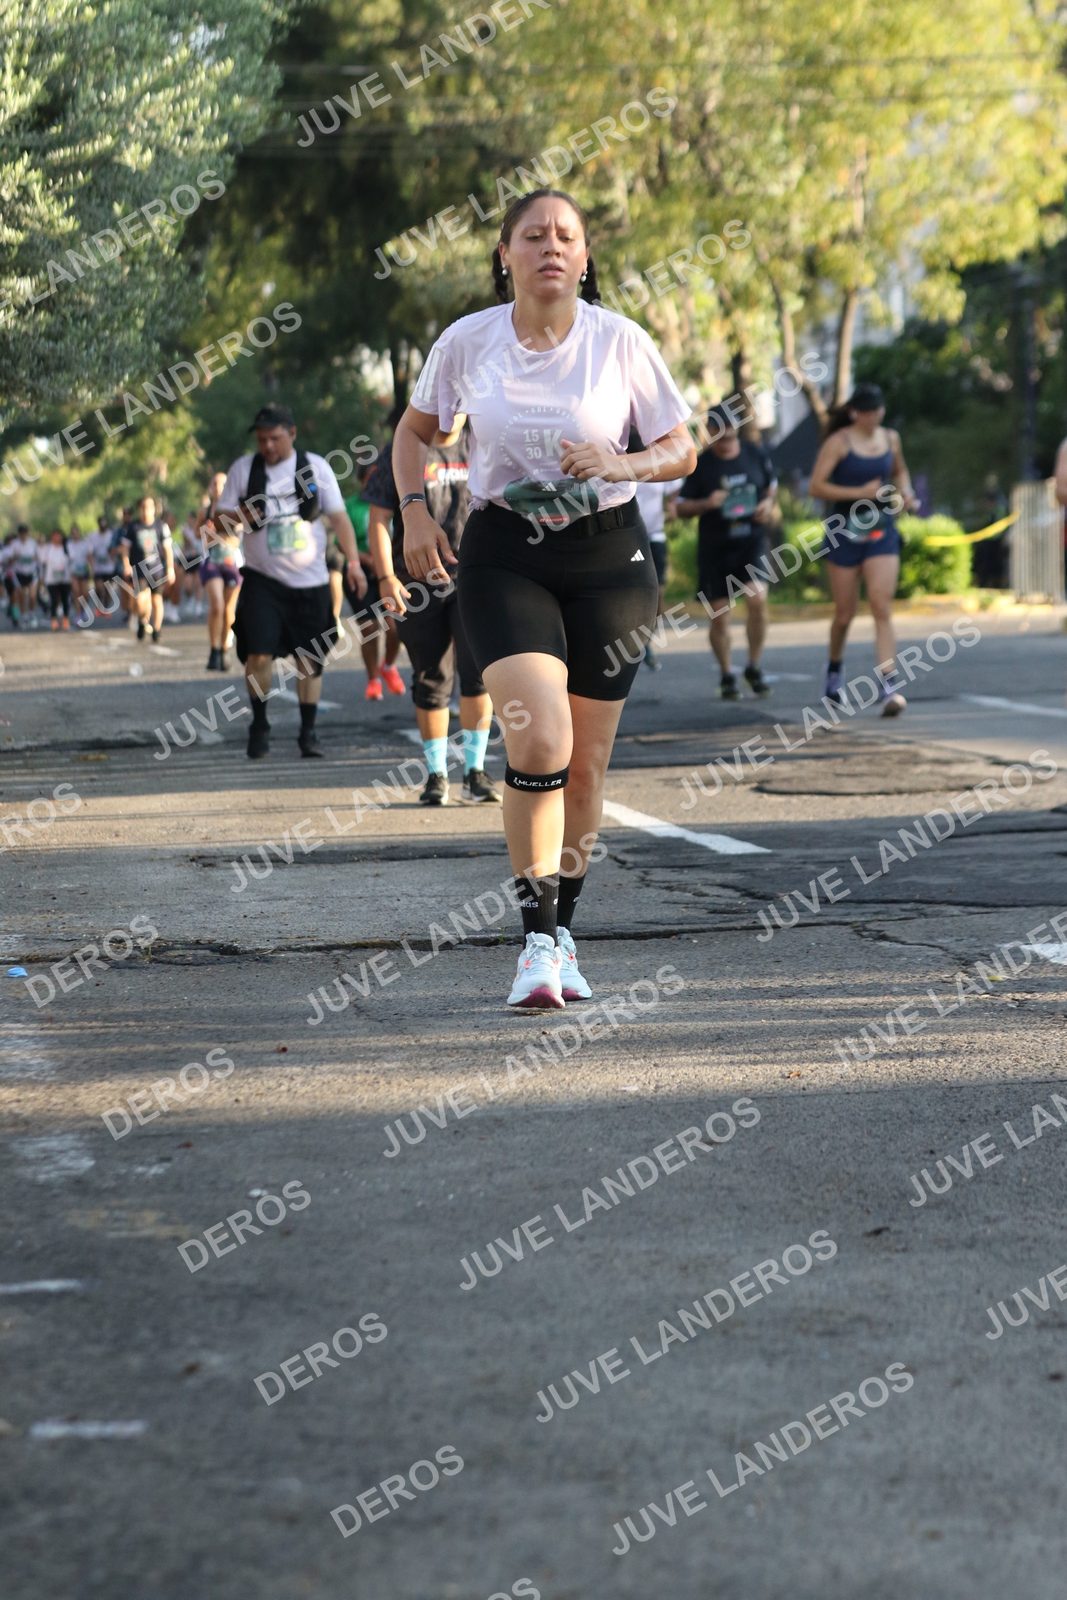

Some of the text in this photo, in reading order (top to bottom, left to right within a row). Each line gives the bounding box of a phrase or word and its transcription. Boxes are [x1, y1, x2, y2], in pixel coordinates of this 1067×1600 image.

[523, 429, 540, 443] 15
[543, 429, 563, 457] K
[526, 446, 542, 460] 30
[518, 778, 562, 787] MUELLER
